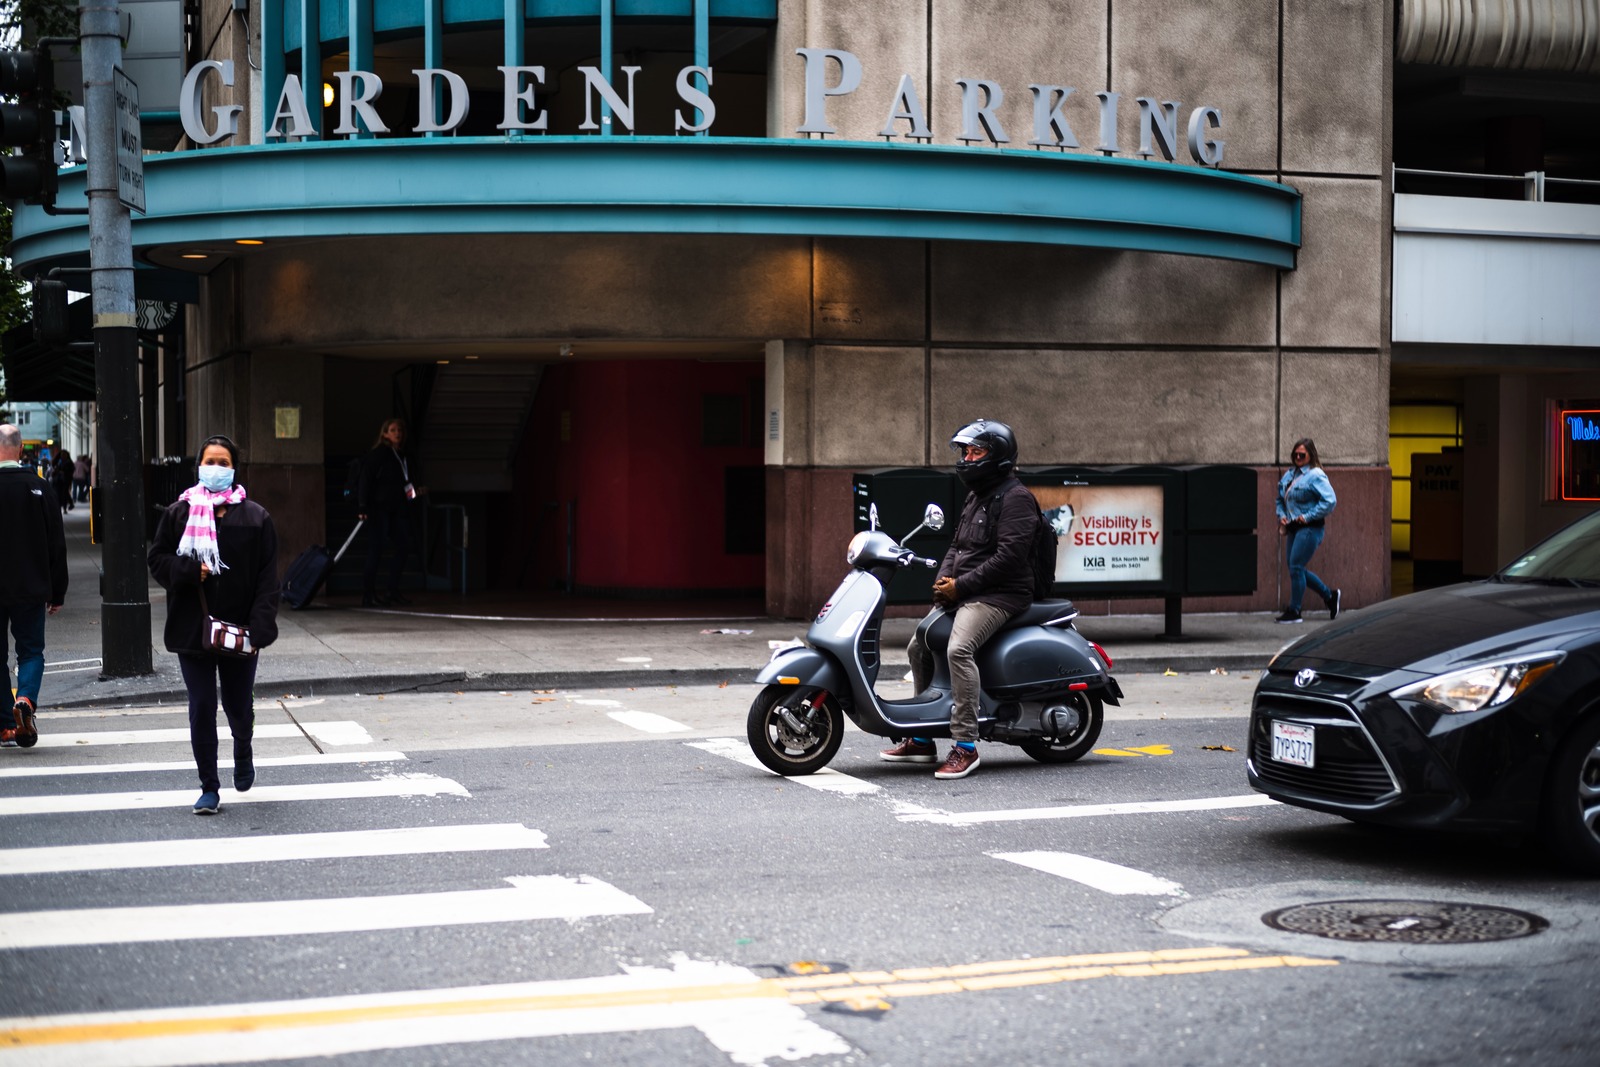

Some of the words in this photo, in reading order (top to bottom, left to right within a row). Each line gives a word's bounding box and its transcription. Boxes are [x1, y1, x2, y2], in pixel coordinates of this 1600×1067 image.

[180, 58, 717, 144] GARDENS
[796, 48, 1226, 167] PARKING
[121, 127, 137, 154] MUST
[118, 163, 131, 184] TURN
[131, 170, 143, 190] RIGHT
[1425, 465, 1453, 476] PAY
[1419, 479, 1459, 491] HERE
[1082, 515, 1138, 531] Visibility
[1141, 515, 1152, 528] is
[1074, 531, 1160, 546] SECURITY
[1083, 554, 1106, 567] ixia
[1275, 736, 1312, 762] 7YPS737
